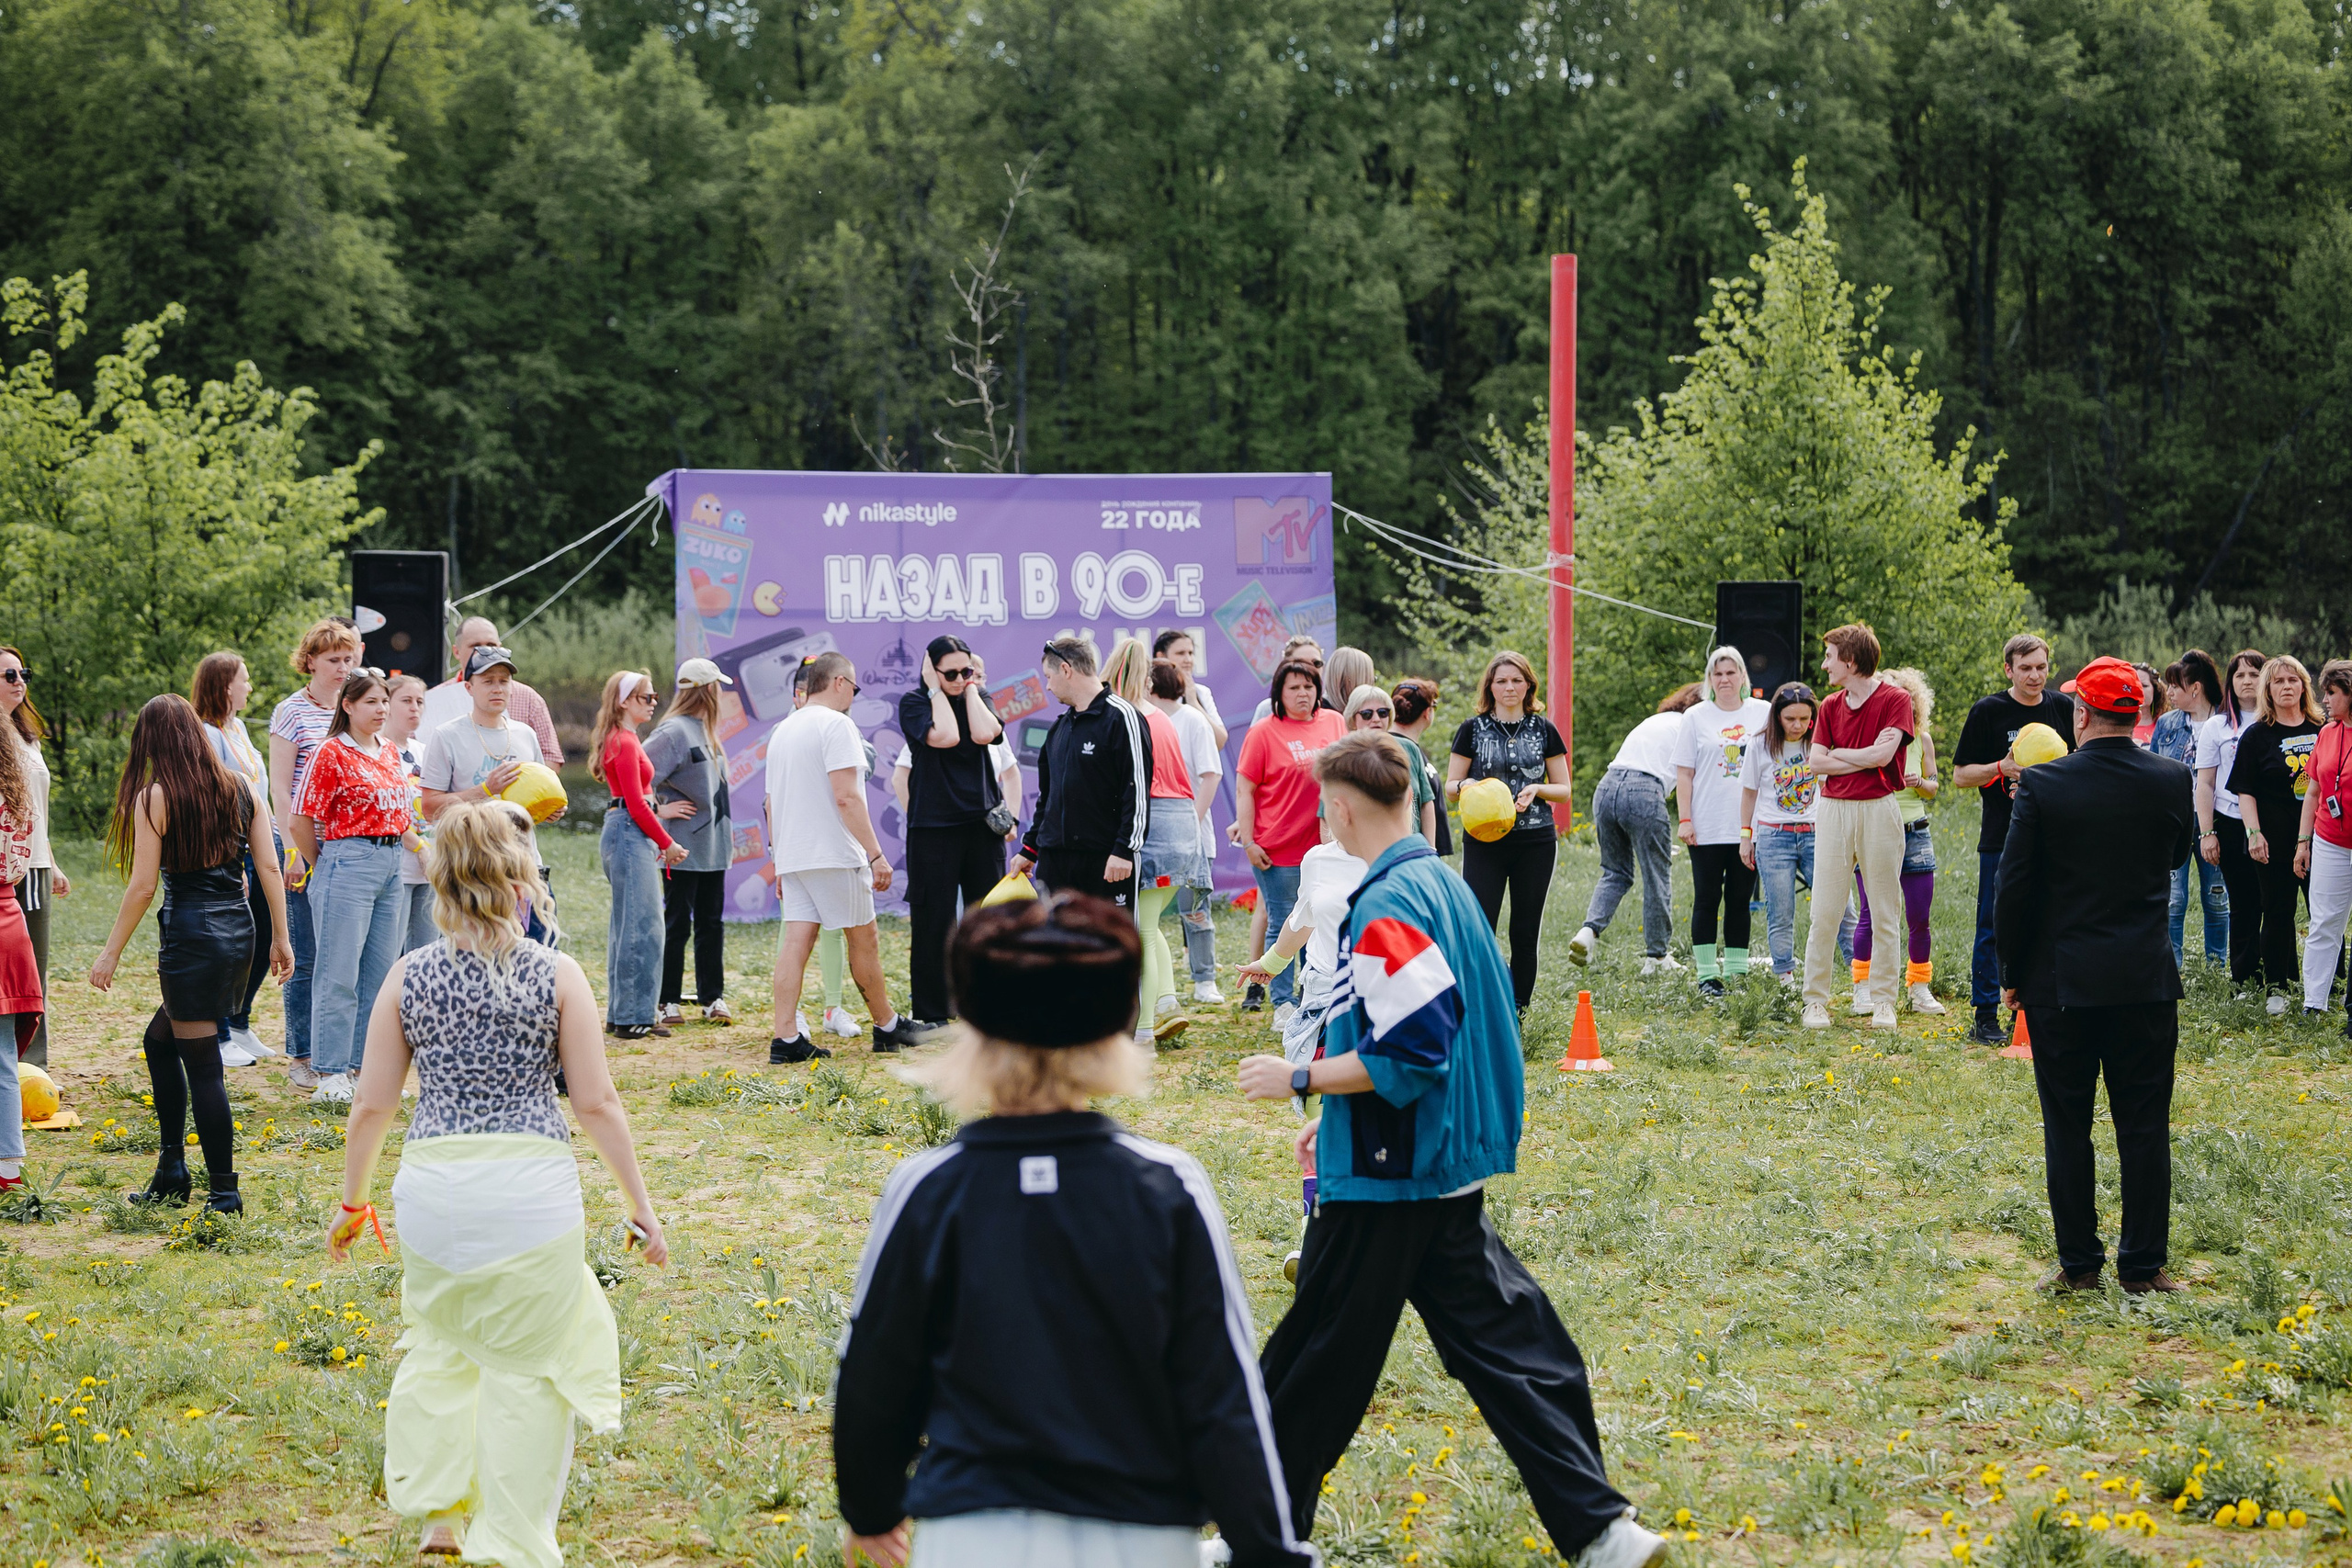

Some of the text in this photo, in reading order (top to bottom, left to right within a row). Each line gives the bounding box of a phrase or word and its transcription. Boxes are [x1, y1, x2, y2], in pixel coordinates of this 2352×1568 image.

[858, 502, 958, 527] nikastyle
[1101, 510, 1202, 533] 22 ГОДА
[1234, 496, 1327, 565] MTV
[683, 535, 743, 565] ZUKO
[823, 553, 1010, 627] НАЗАД
[1019, 552, 1060, 620] В
